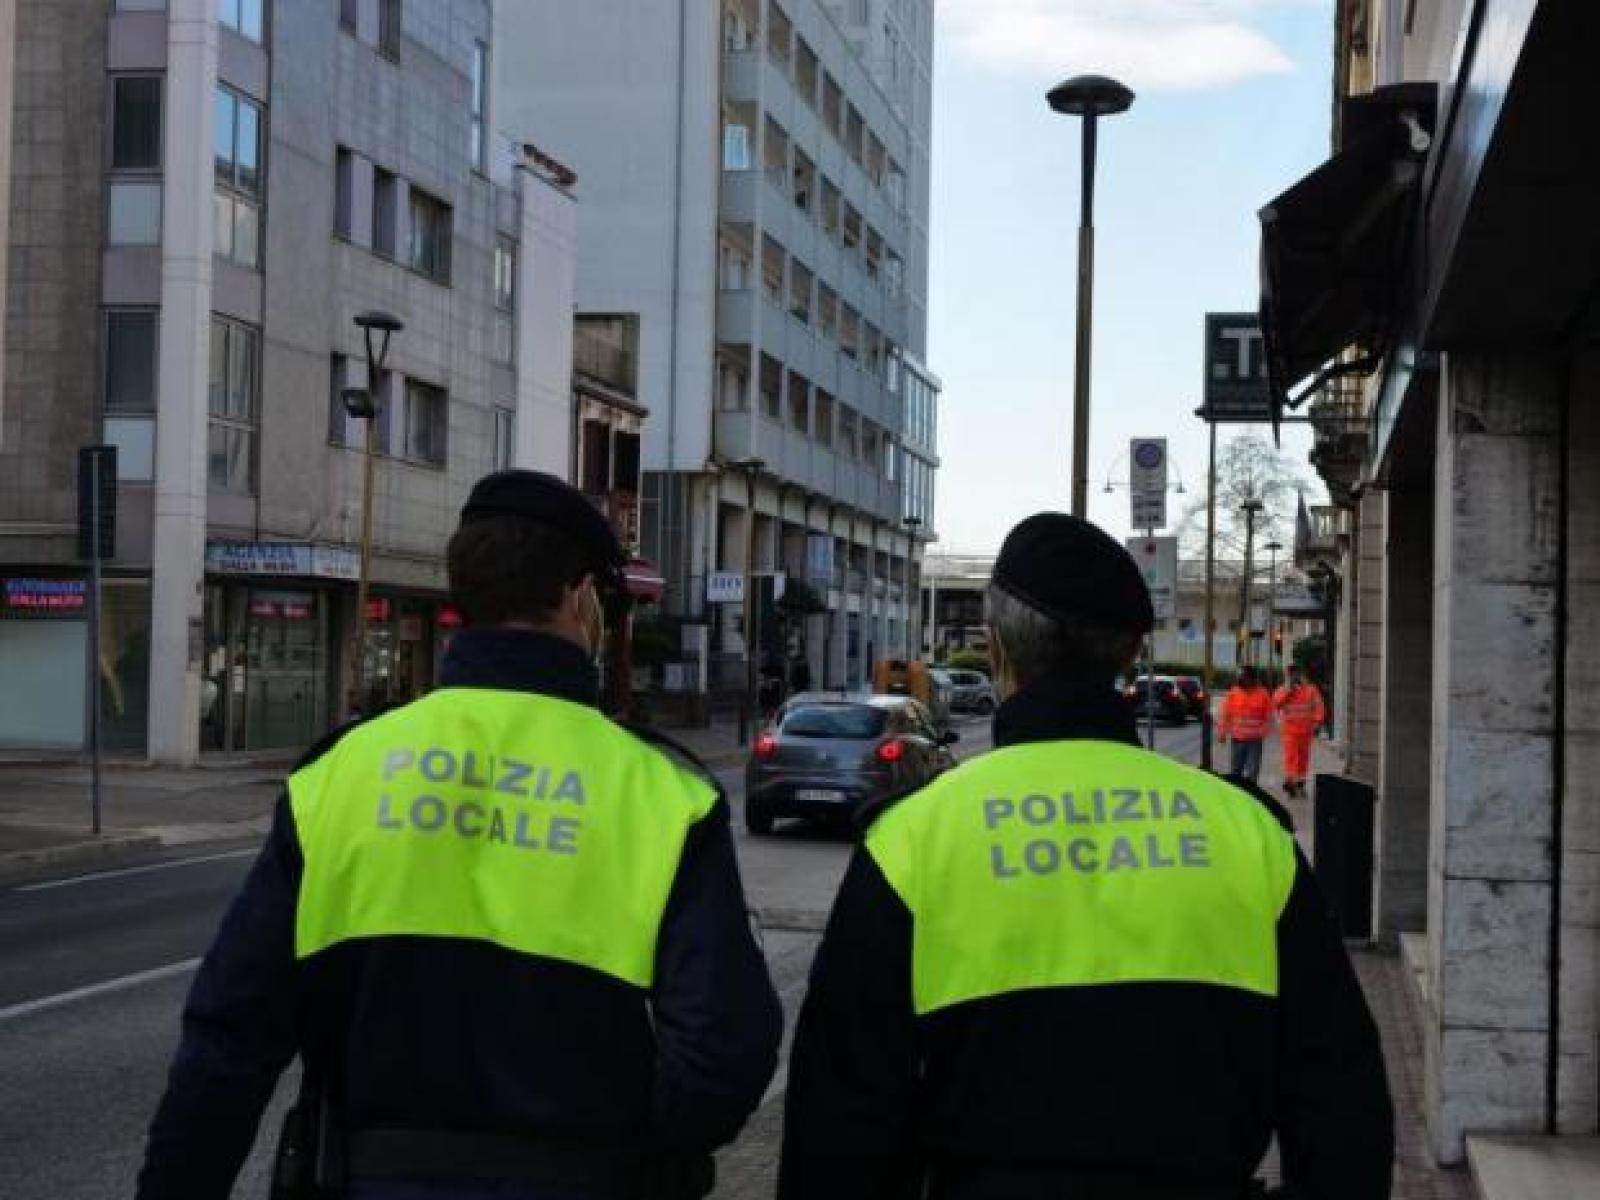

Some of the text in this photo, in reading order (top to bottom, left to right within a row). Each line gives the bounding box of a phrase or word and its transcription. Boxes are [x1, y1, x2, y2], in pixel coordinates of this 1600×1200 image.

[381, 748, 586, 806] POLIZIA
[377, 793, 580, 855] LOCALE
[983, 788, 1202, 829] POLIZIA
[990, 832, 1212, 878] LOCALE
